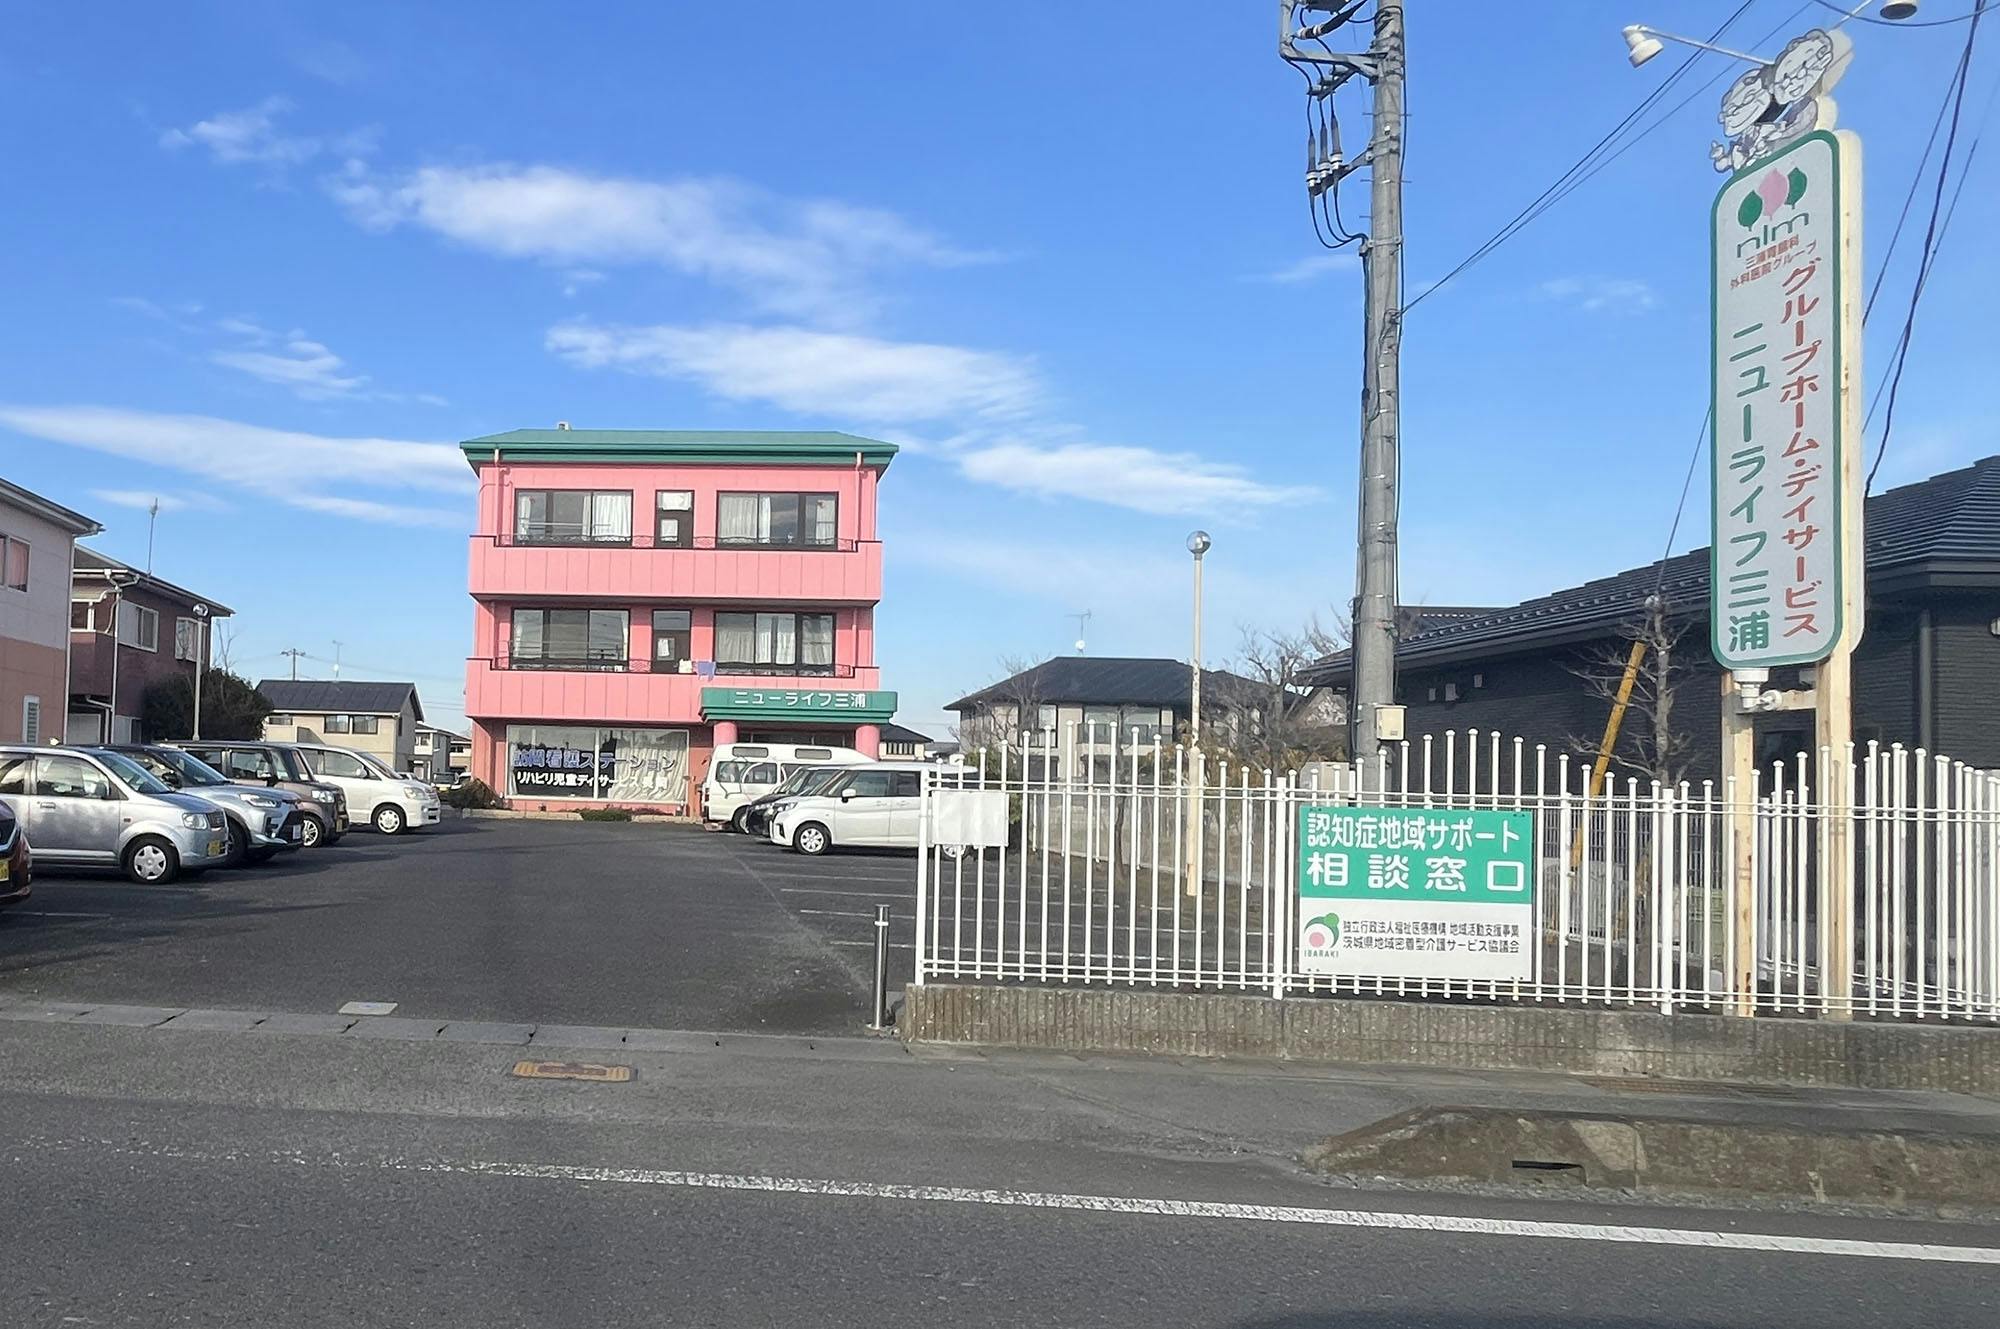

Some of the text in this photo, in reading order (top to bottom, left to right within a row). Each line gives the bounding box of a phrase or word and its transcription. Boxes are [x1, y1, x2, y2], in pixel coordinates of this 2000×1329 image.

[1728, 322, 1771, 652] ニューライフ三浦
[734, 691, 866, 708] ニューライフ三浦
[1307, 813, 1521, 853] 認知症地域サポート
[1306, 851, 1525, 892] 相談窓口
[1343, 920, 1520, 938] 独立行政法人福祉医療機構 地域活動支援事業
[1304, 949, 1339, 958] IBARAKI
[1343, 936, 1520, 953] 茨城県地域密着型介護サービス協議会
